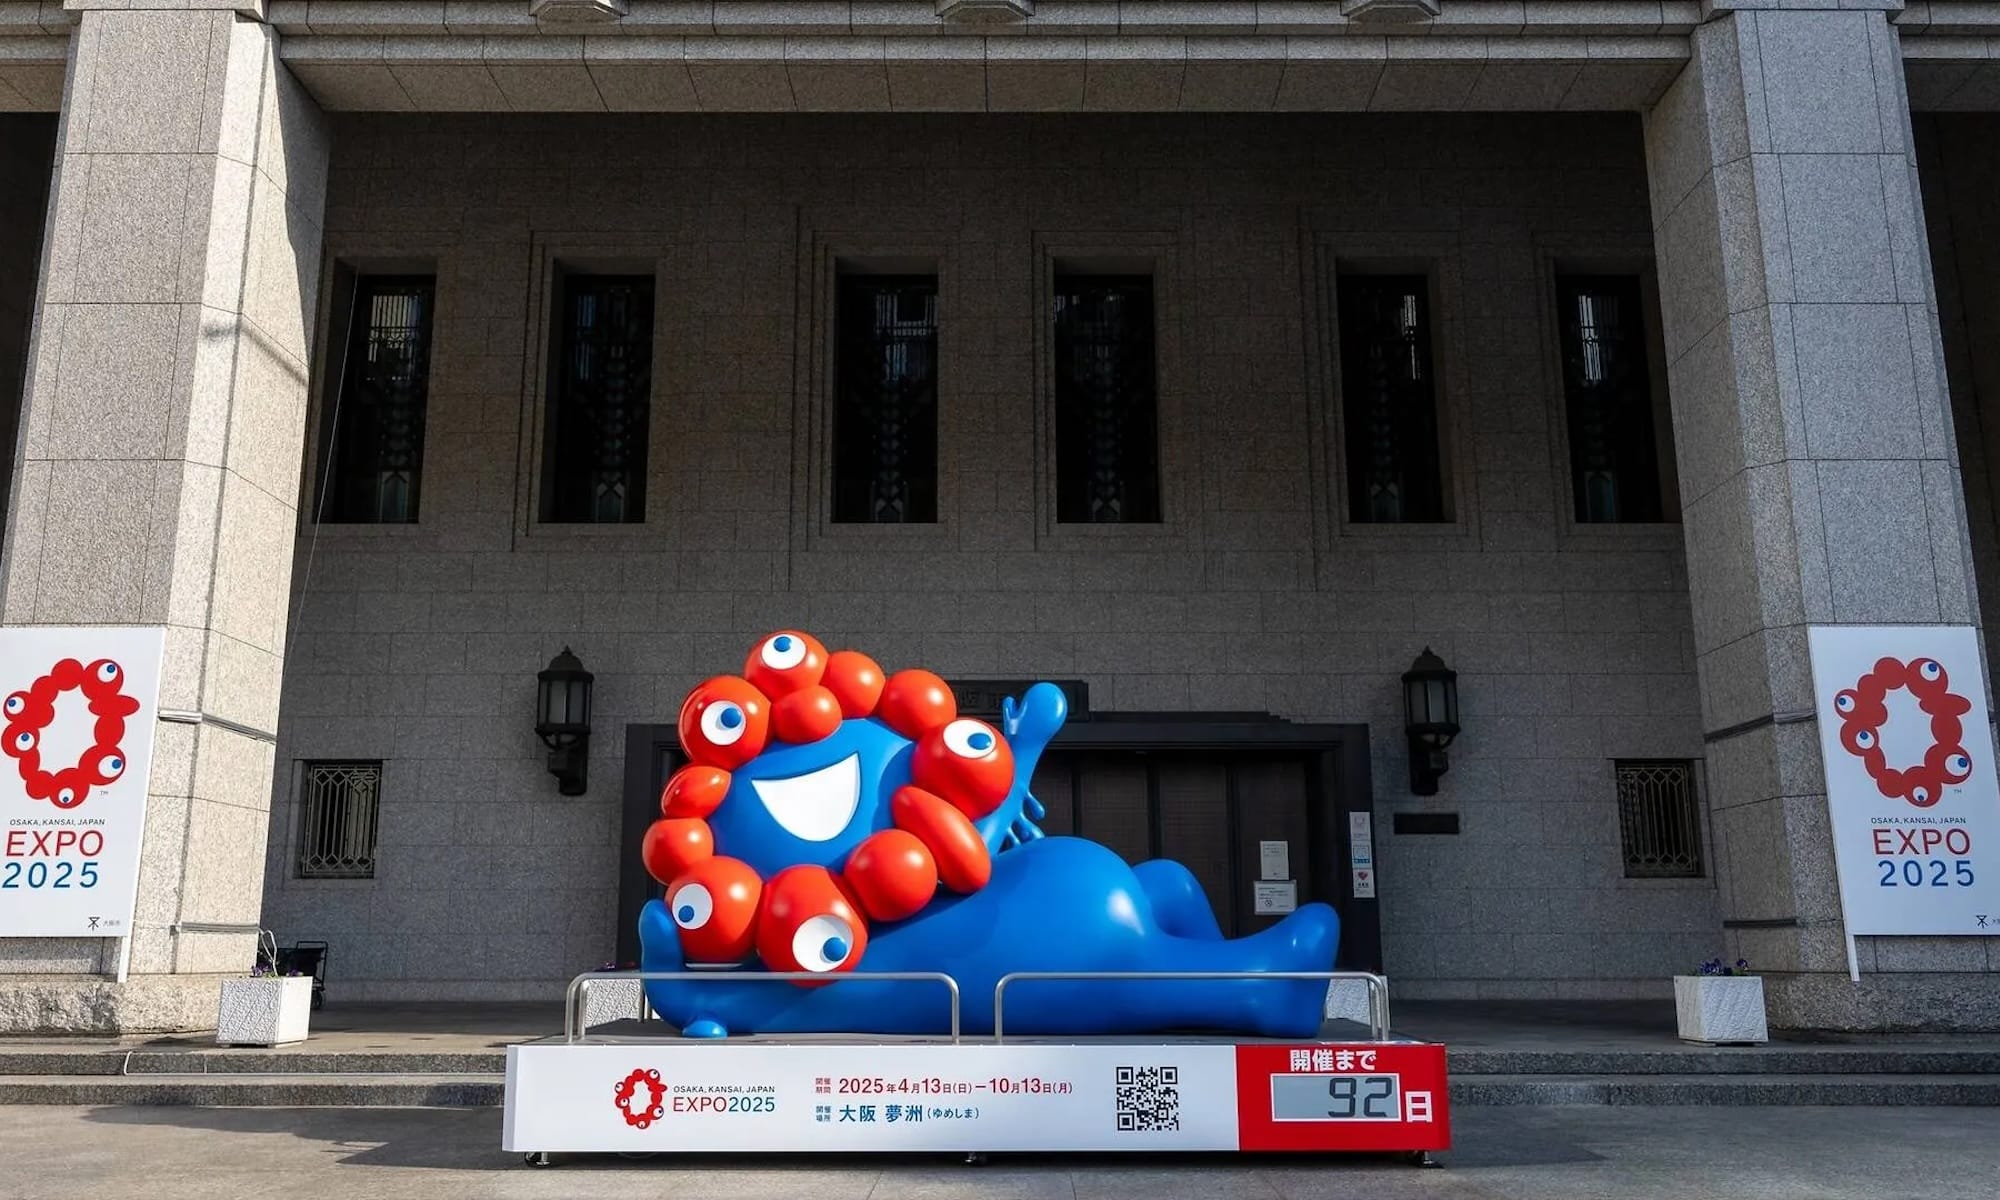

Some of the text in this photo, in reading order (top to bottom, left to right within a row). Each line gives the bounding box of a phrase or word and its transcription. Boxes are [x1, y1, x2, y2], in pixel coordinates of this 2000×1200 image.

[9, 818, 105, 827] OSAKA, KANSAI, JAPAN
[1870, 817, 1903, 825] OSAKA,
[1903, 817, 1938, 825] KANSAI,
[6, 830, 104, 857] EXPO
[1872, 828, 1971, 856] EXPO
[2, 861, 99, 889] 2025
[1878, 859, 1975, 887] 2025
[1289, 1049, 1377, 1072] 開催まで
[673, 1085, 776, 1094] OSAKA, KANSAI, JAPAN
[1328, 1077, 1393, 1118] 92
[673, 1096, 776, 1113] EXPO2025
[839, 1104, 877, 1122] 大阪
[1405, 1091, 1433, 1123] 日
